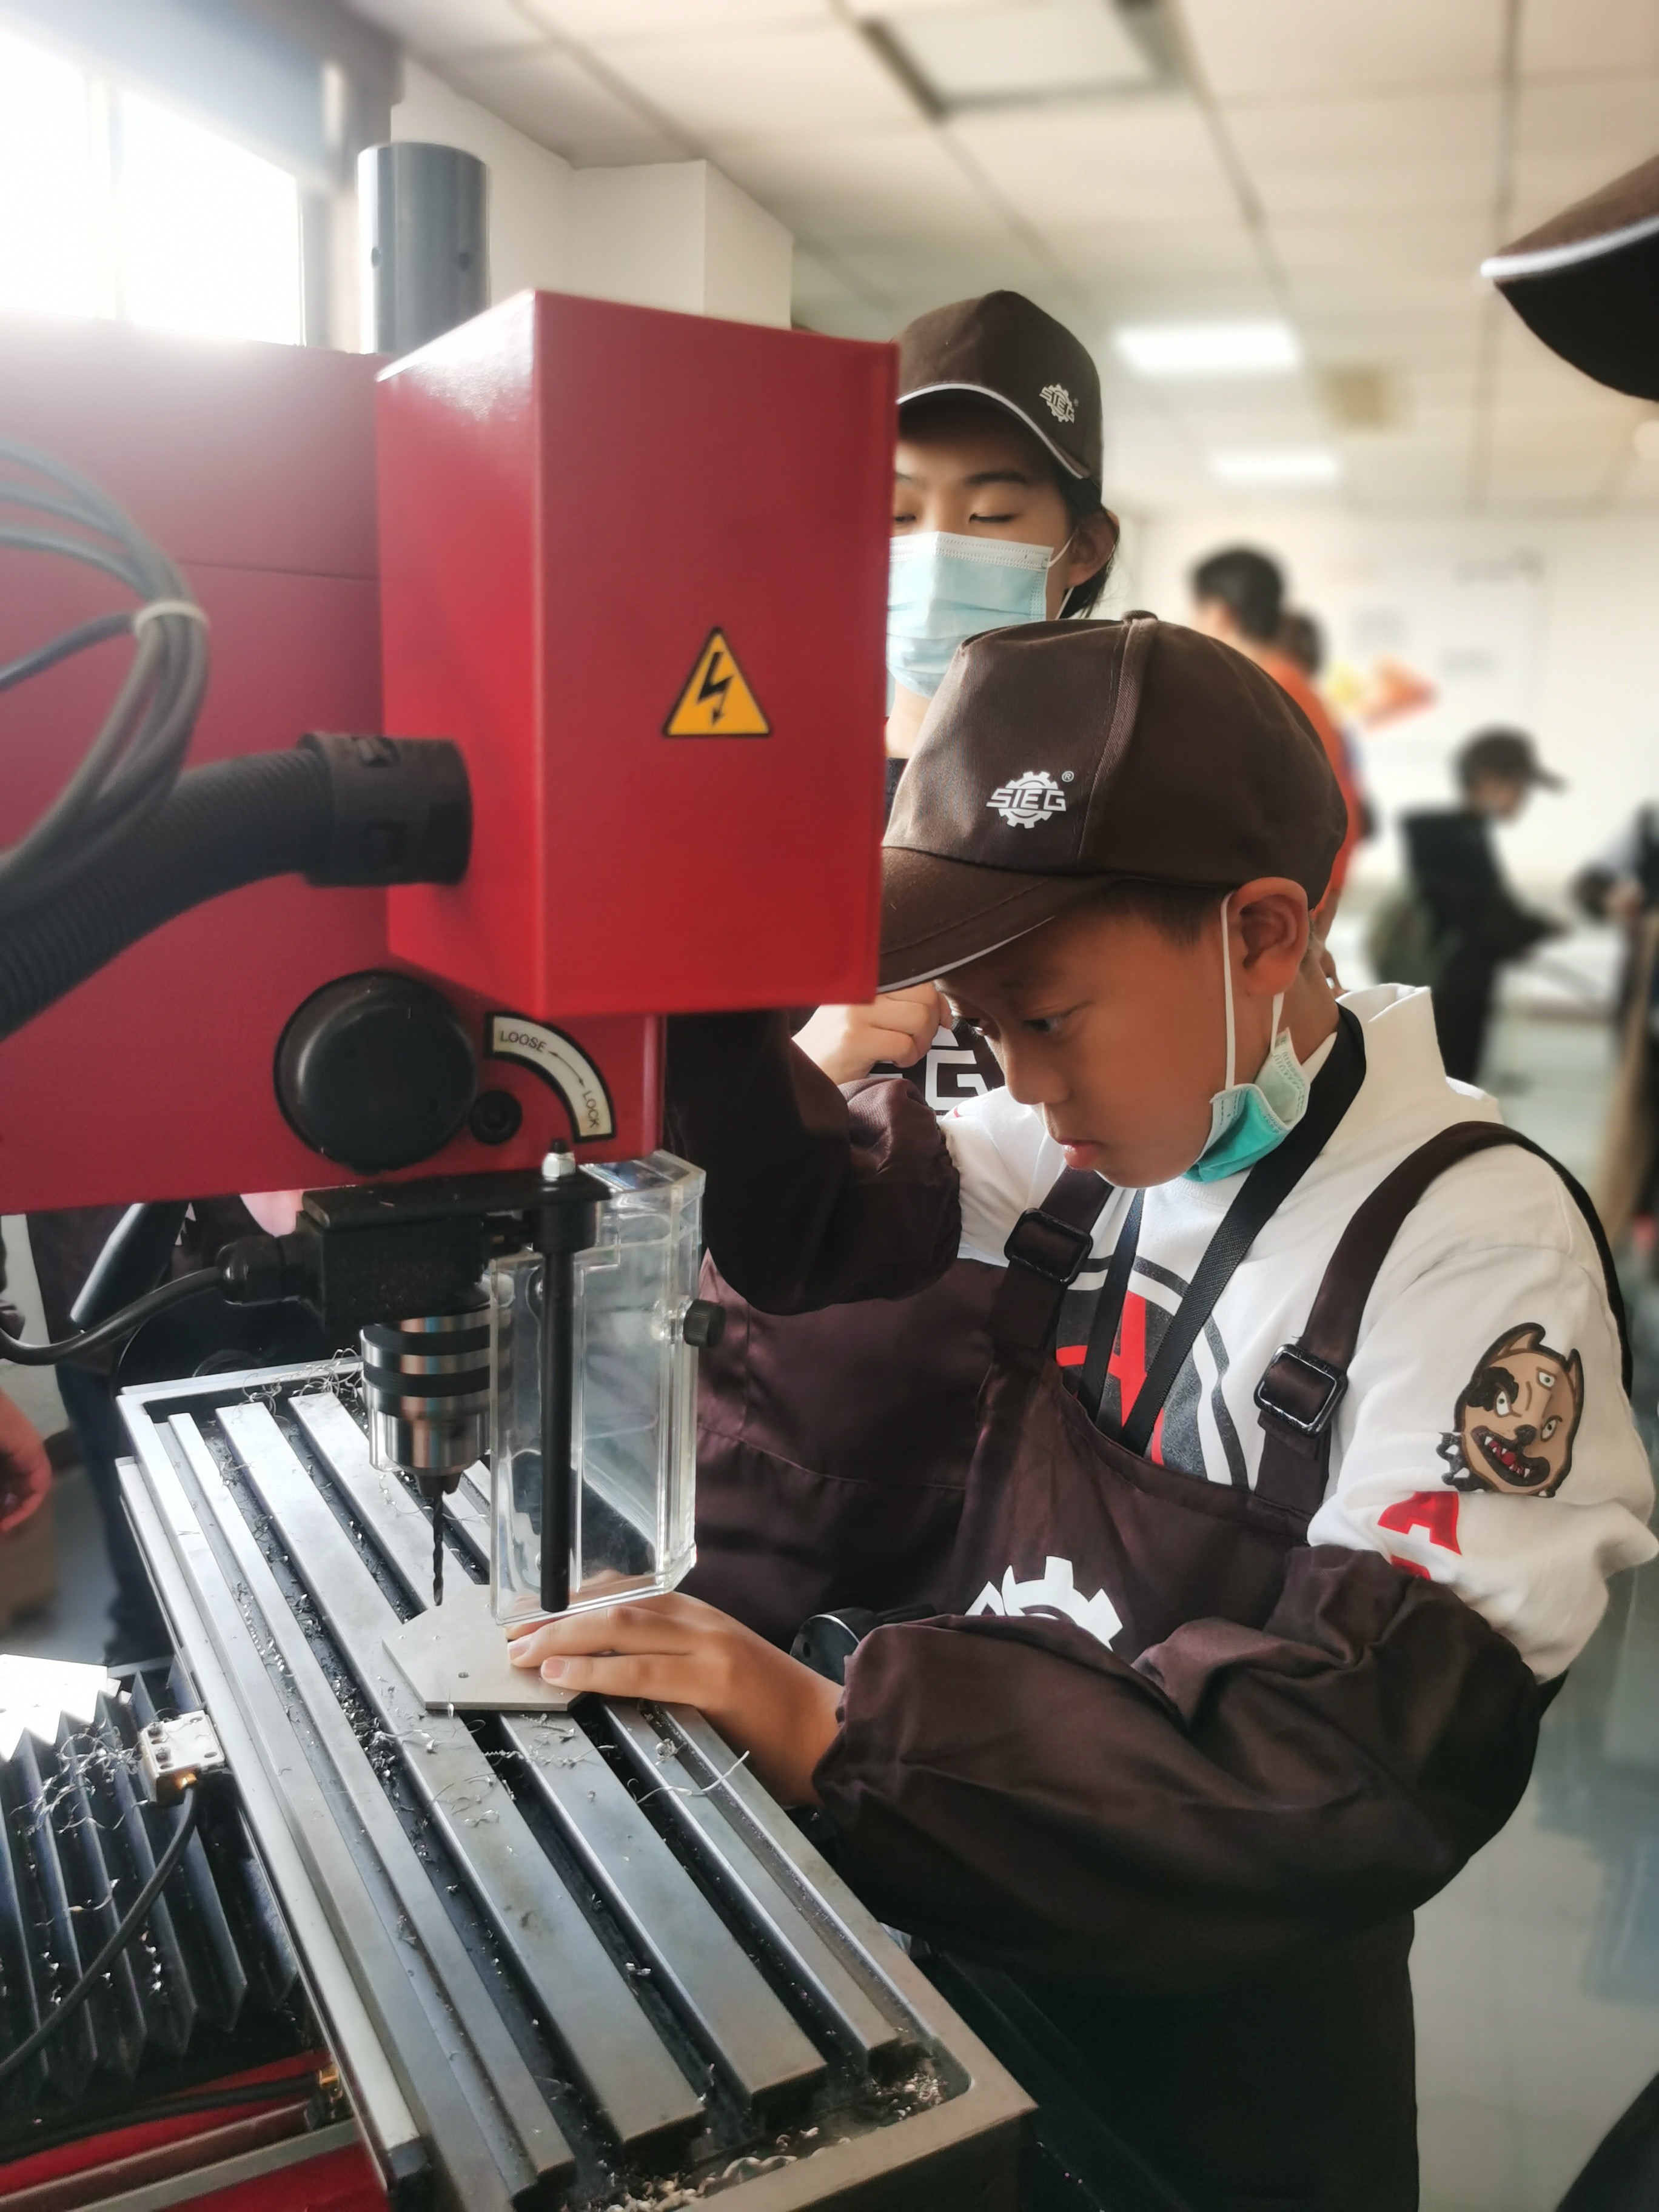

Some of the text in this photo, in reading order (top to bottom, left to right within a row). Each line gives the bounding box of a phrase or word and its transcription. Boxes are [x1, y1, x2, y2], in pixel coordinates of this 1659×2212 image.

[1039, 386, 1074, 423] SIEG
[986, 788, 1067, 812] SIEG
[500, 1030, 600, 1128] LOOSE LOCK
